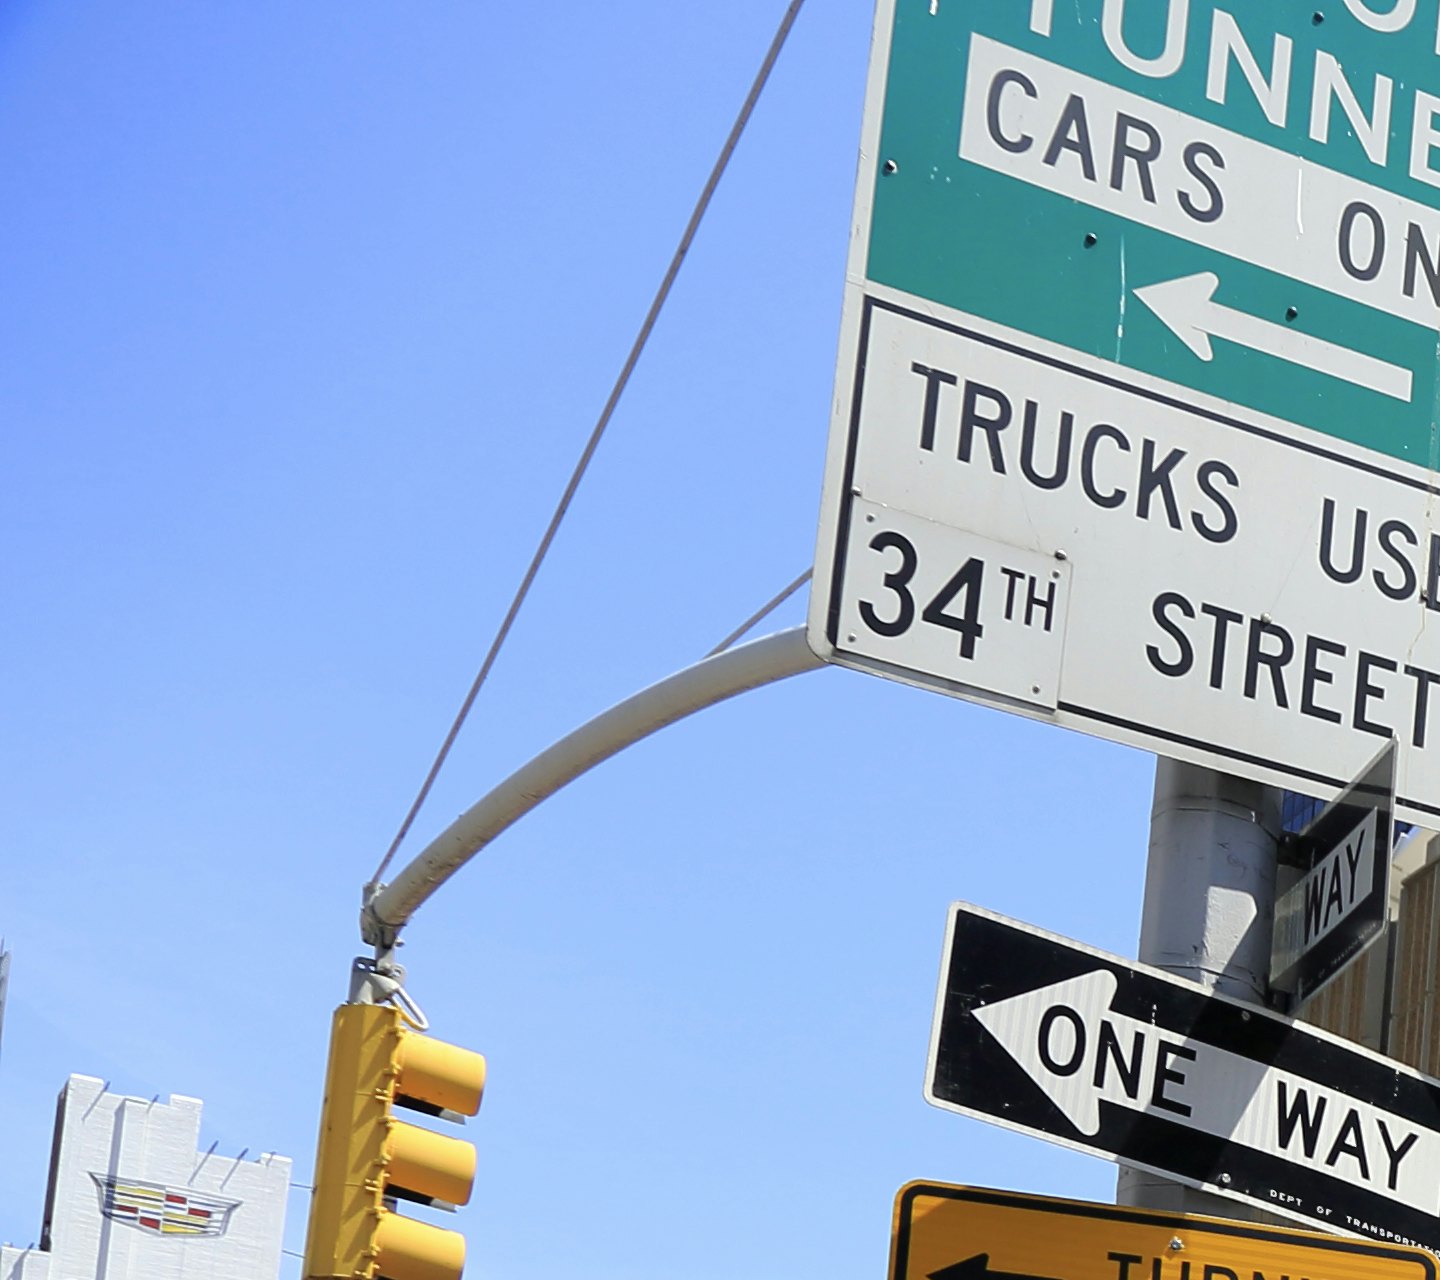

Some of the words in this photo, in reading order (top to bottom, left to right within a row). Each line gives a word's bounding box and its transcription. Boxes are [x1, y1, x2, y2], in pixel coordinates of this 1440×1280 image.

[986, 68, 1226, 224] CARS
[912, 362, 1240, 543] TRUCKS
[1303, 829, 1366, 945] WAY
[1037, 1005, 1194, 1119] ONE
[1277, 1080, 1421, 1192] WAY
[1270, 1189, 1302, 1207] DEPT
[1316, 1205, 1333, 1216] OF
